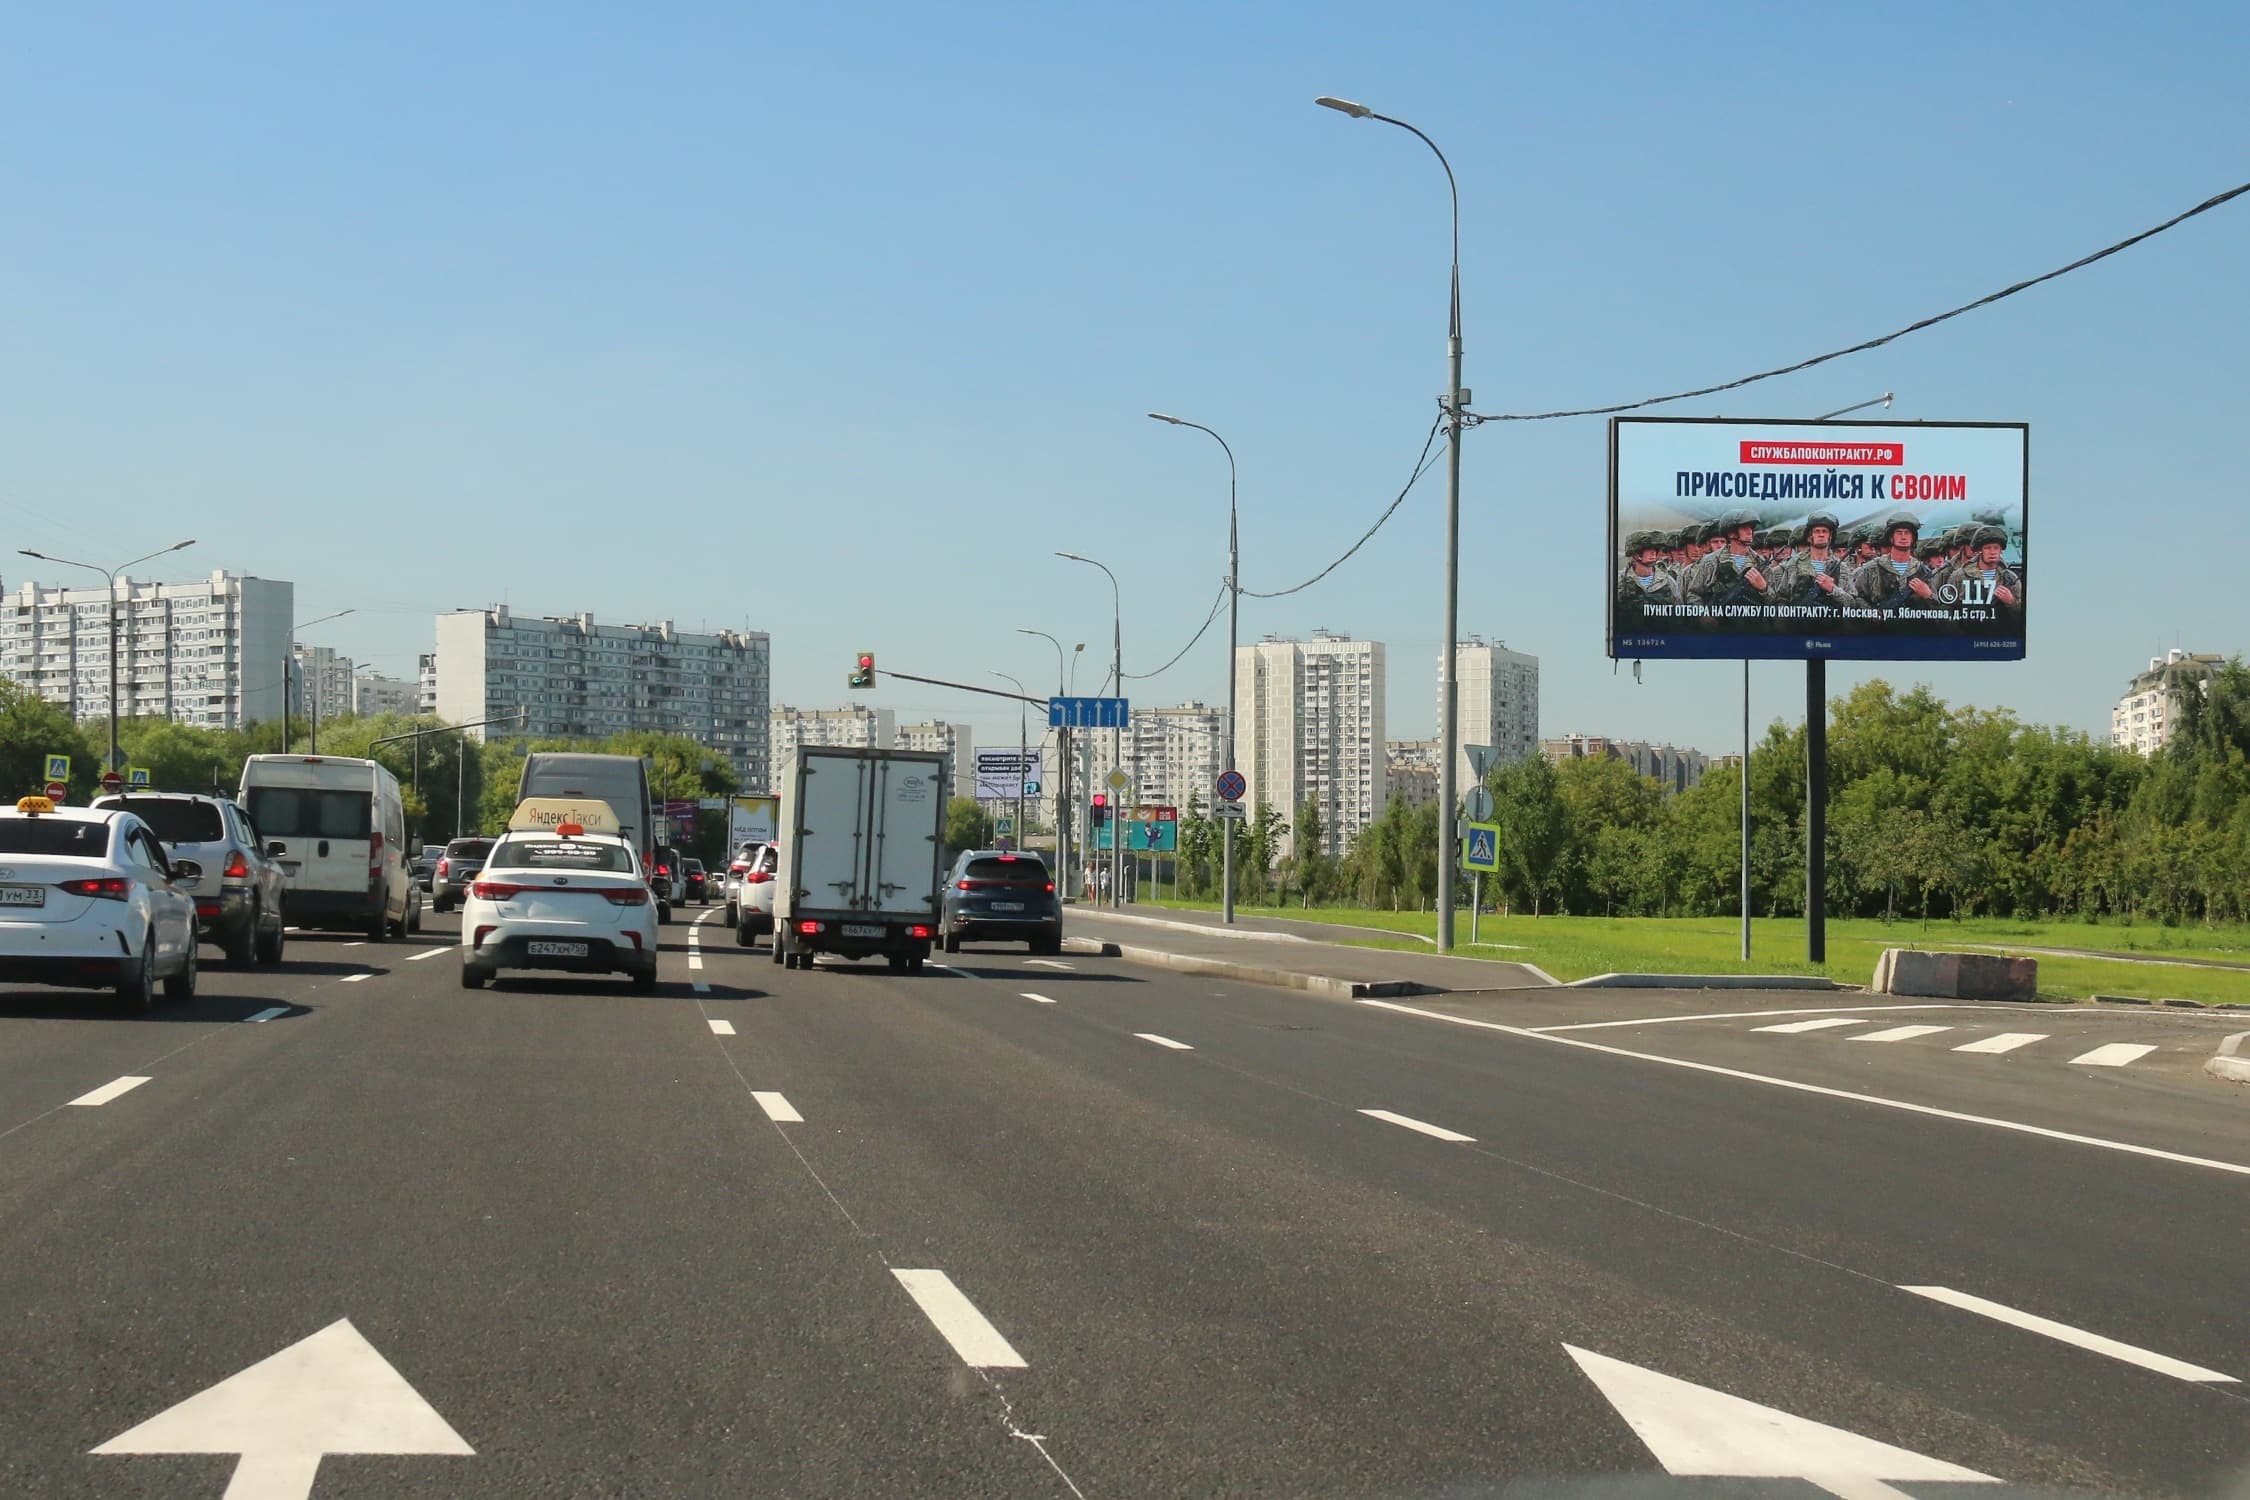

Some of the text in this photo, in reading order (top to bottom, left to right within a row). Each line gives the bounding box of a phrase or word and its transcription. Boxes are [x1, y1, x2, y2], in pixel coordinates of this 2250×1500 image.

[1750, 446, 1893, 461] СЛУЖБАПОКОНТРАКТУ.РФ
[1676, 468, 1966, 501] ПРИСОЕДИНЯЙСЯ К СВОИМ
[1962, 580, 1996, 604] 117
[1643, 604, 1674, 617] ПУНКТ
[1675, 604, 1710, 617] ОТБОРА
[1711, 605, 1724, 617] НА
[1725, 605, 1761, 617] СЛУЖБУ
[1763, 605, 1776, 618] ПО
[1778, 606, 1832, 618] КОНТРАКТУ:
[1833, 609, 1840, 618] г.
[1842, 607, 1881, 620] Москва,
[1883, 609, 1896, 621] ул.
[1899, 607, 1952, 621] Яблочкова,
[1970, 610, 1989, 622] стр.
[1991, 609, 1996, 619] 1
[529, 807, 601, 826] Яндекс Такси
